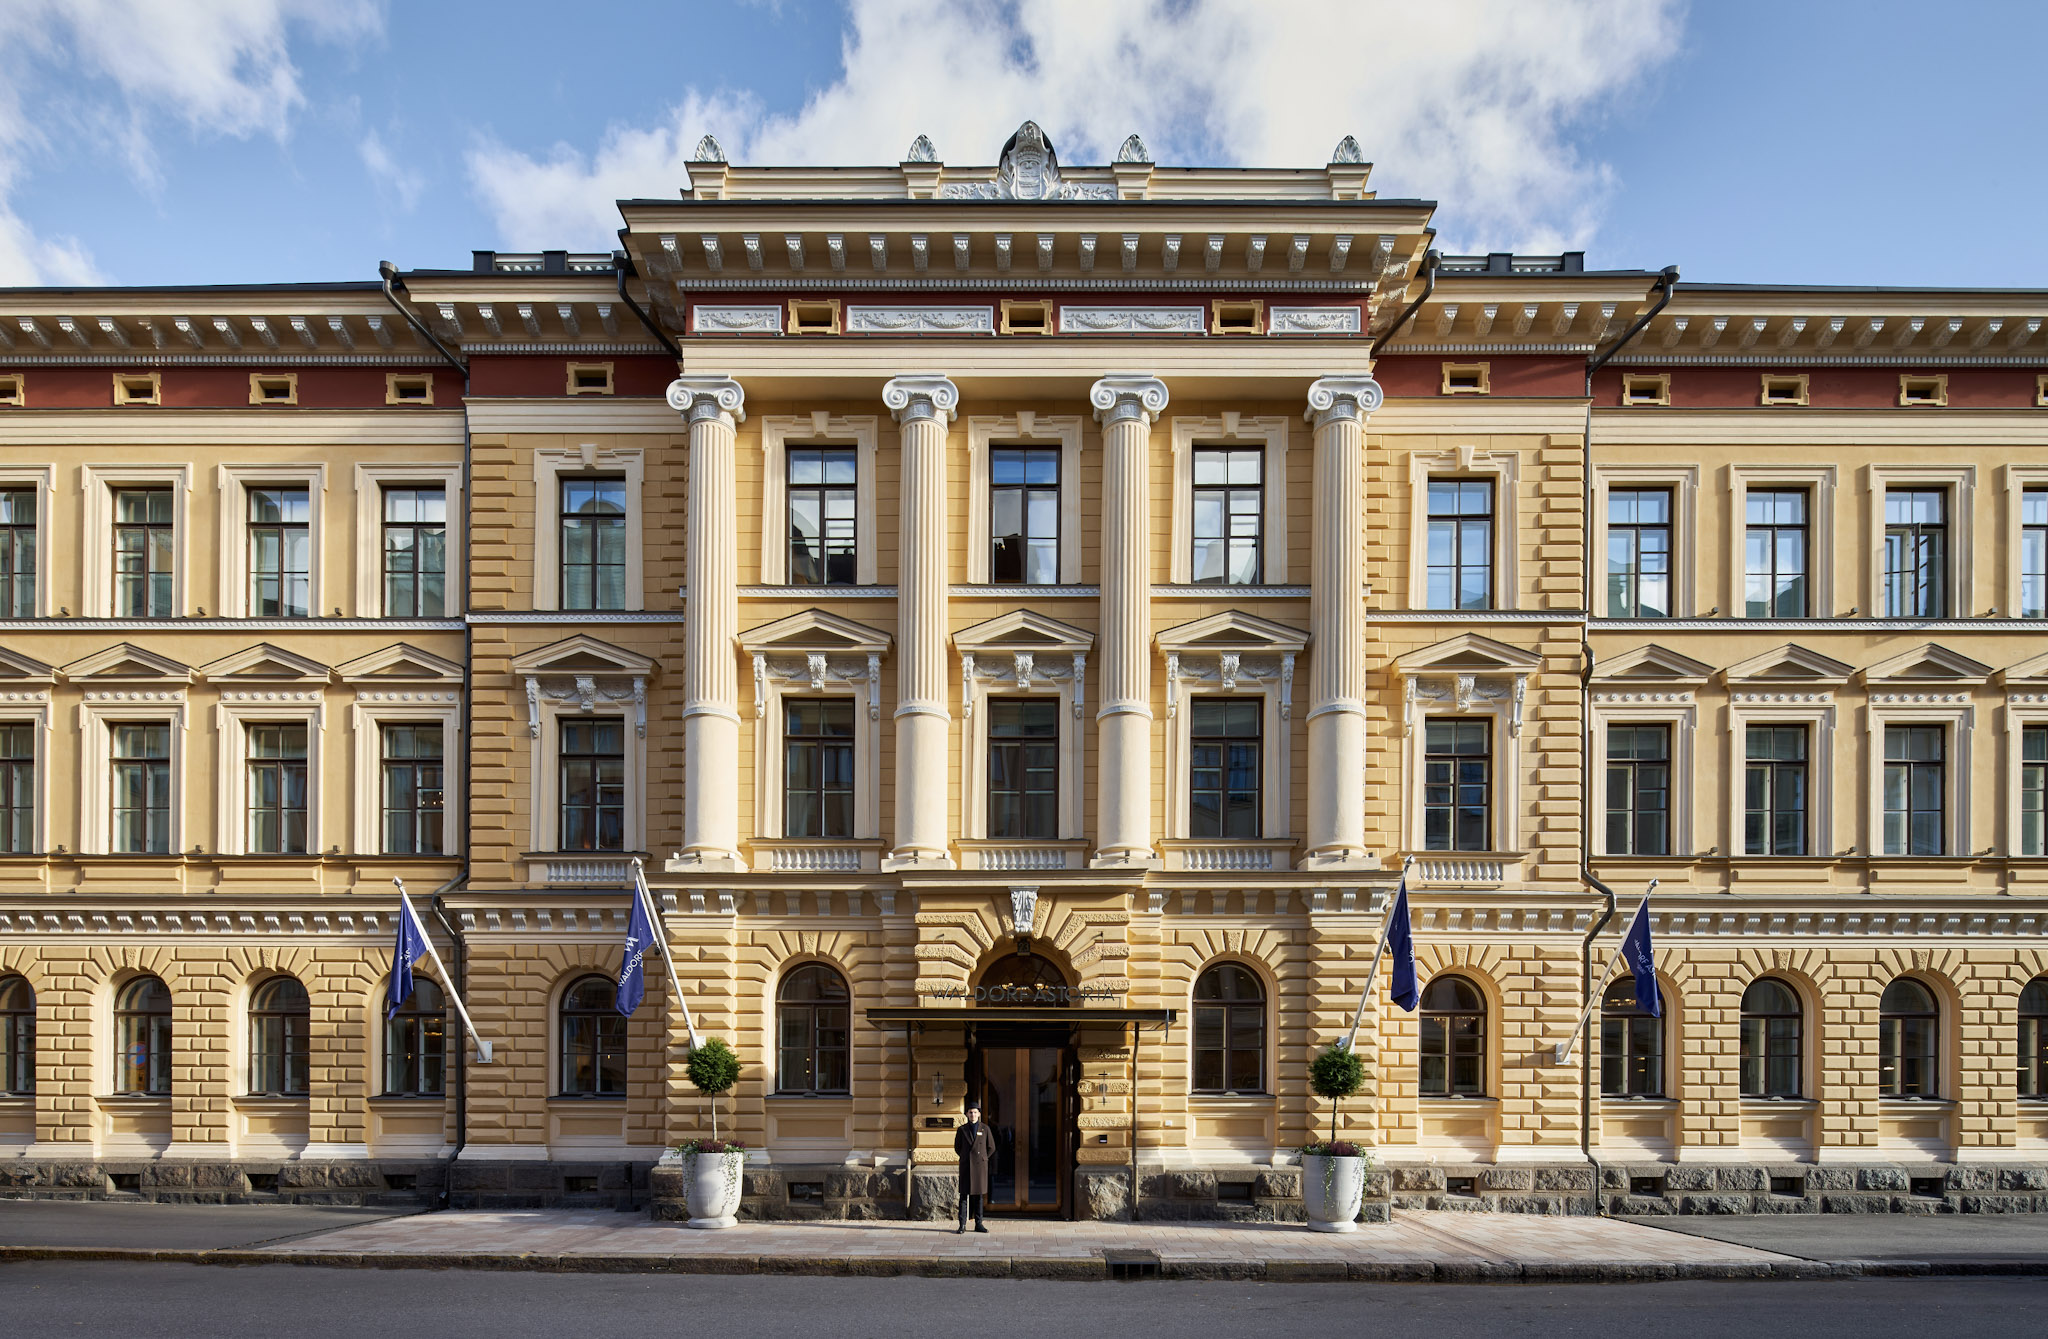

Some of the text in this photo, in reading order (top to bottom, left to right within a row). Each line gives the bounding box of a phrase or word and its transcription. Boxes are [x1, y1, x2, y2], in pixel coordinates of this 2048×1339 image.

[618, 949, 643, 987] WALDORF
[930, 985, 1115, 1002] WALDORF ASTORIA
